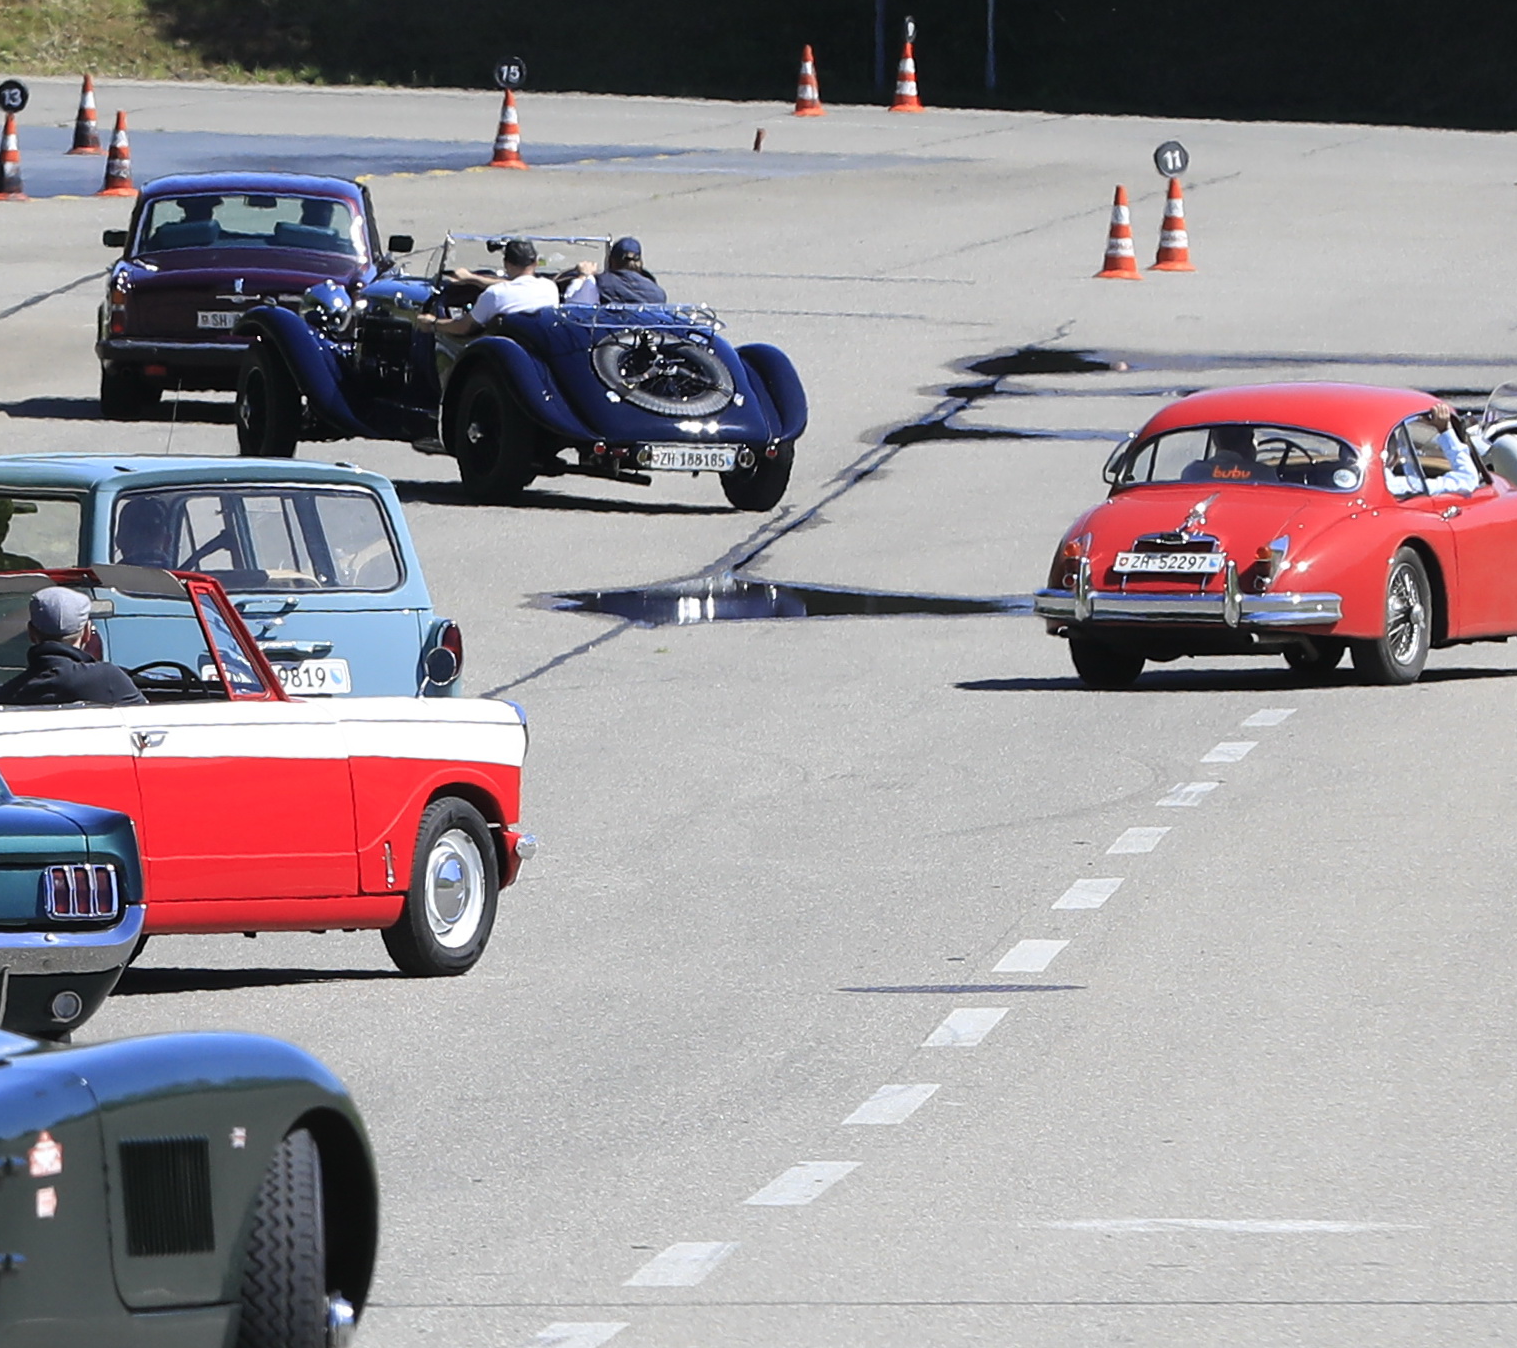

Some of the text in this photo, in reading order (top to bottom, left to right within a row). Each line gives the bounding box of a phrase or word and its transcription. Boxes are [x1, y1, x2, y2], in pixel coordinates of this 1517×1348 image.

[500, 65, 520, 83] 15
[1, 88, 22, 108] 13
[1163, 150, 1182, 170] 11
